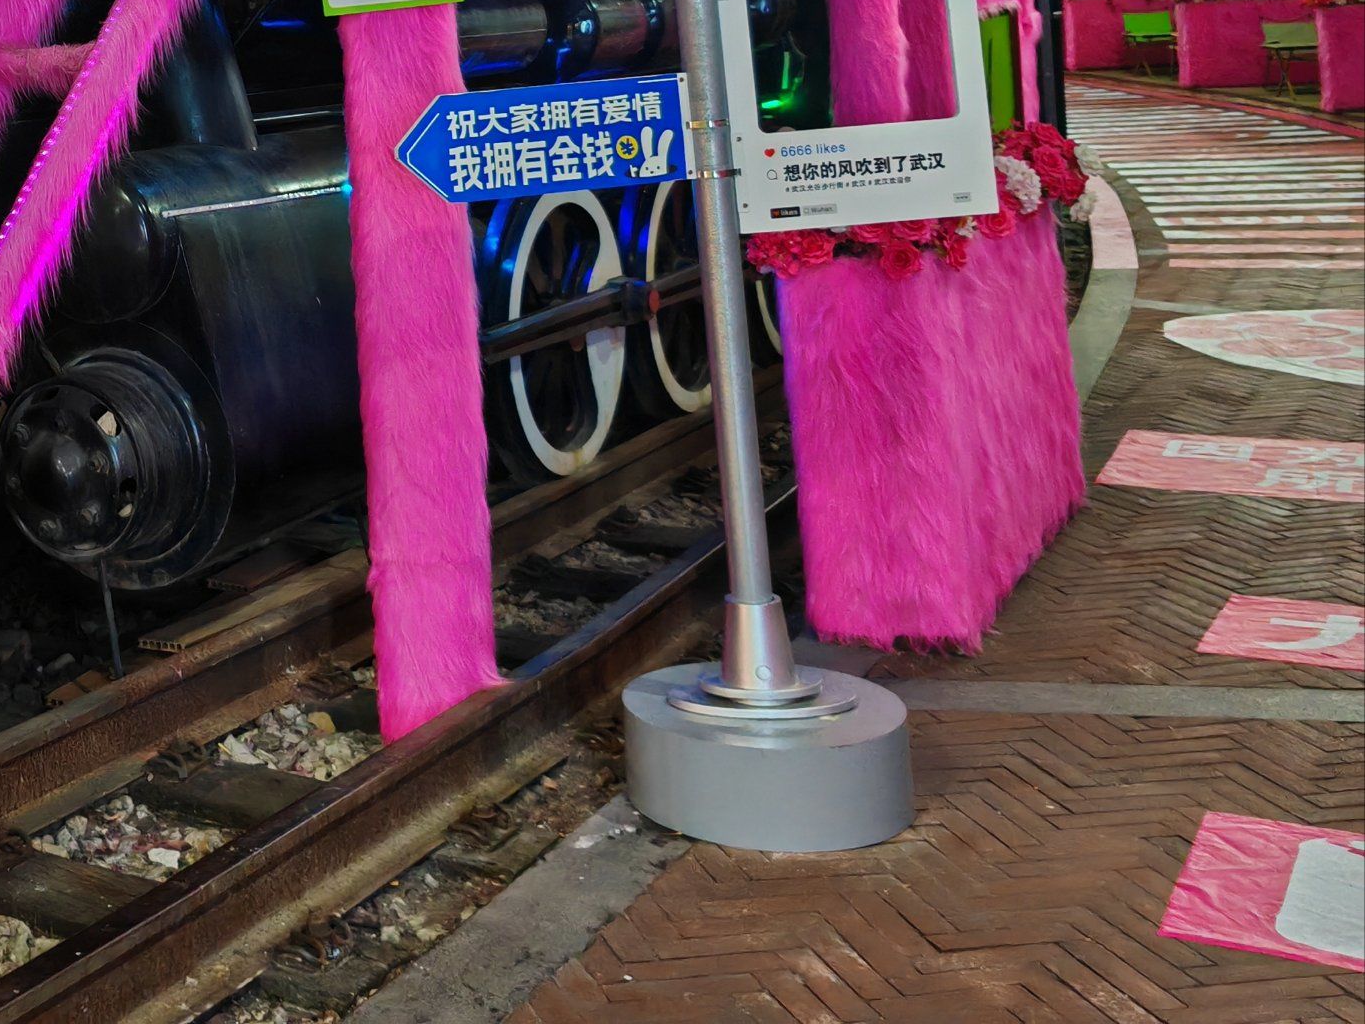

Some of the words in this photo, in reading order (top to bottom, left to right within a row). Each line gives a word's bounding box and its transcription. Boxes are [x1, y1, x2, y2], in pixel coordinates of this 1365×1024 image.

[446, 92, 662, 140] 祝大家拥有爱情
[448, 130, 616, 193] 我拥有金钱
[780, 144, 812, 157] 6666
[816, 143, 846, 155] likes
[784, 153, 946, 182] 想你的风吹到了武汉
